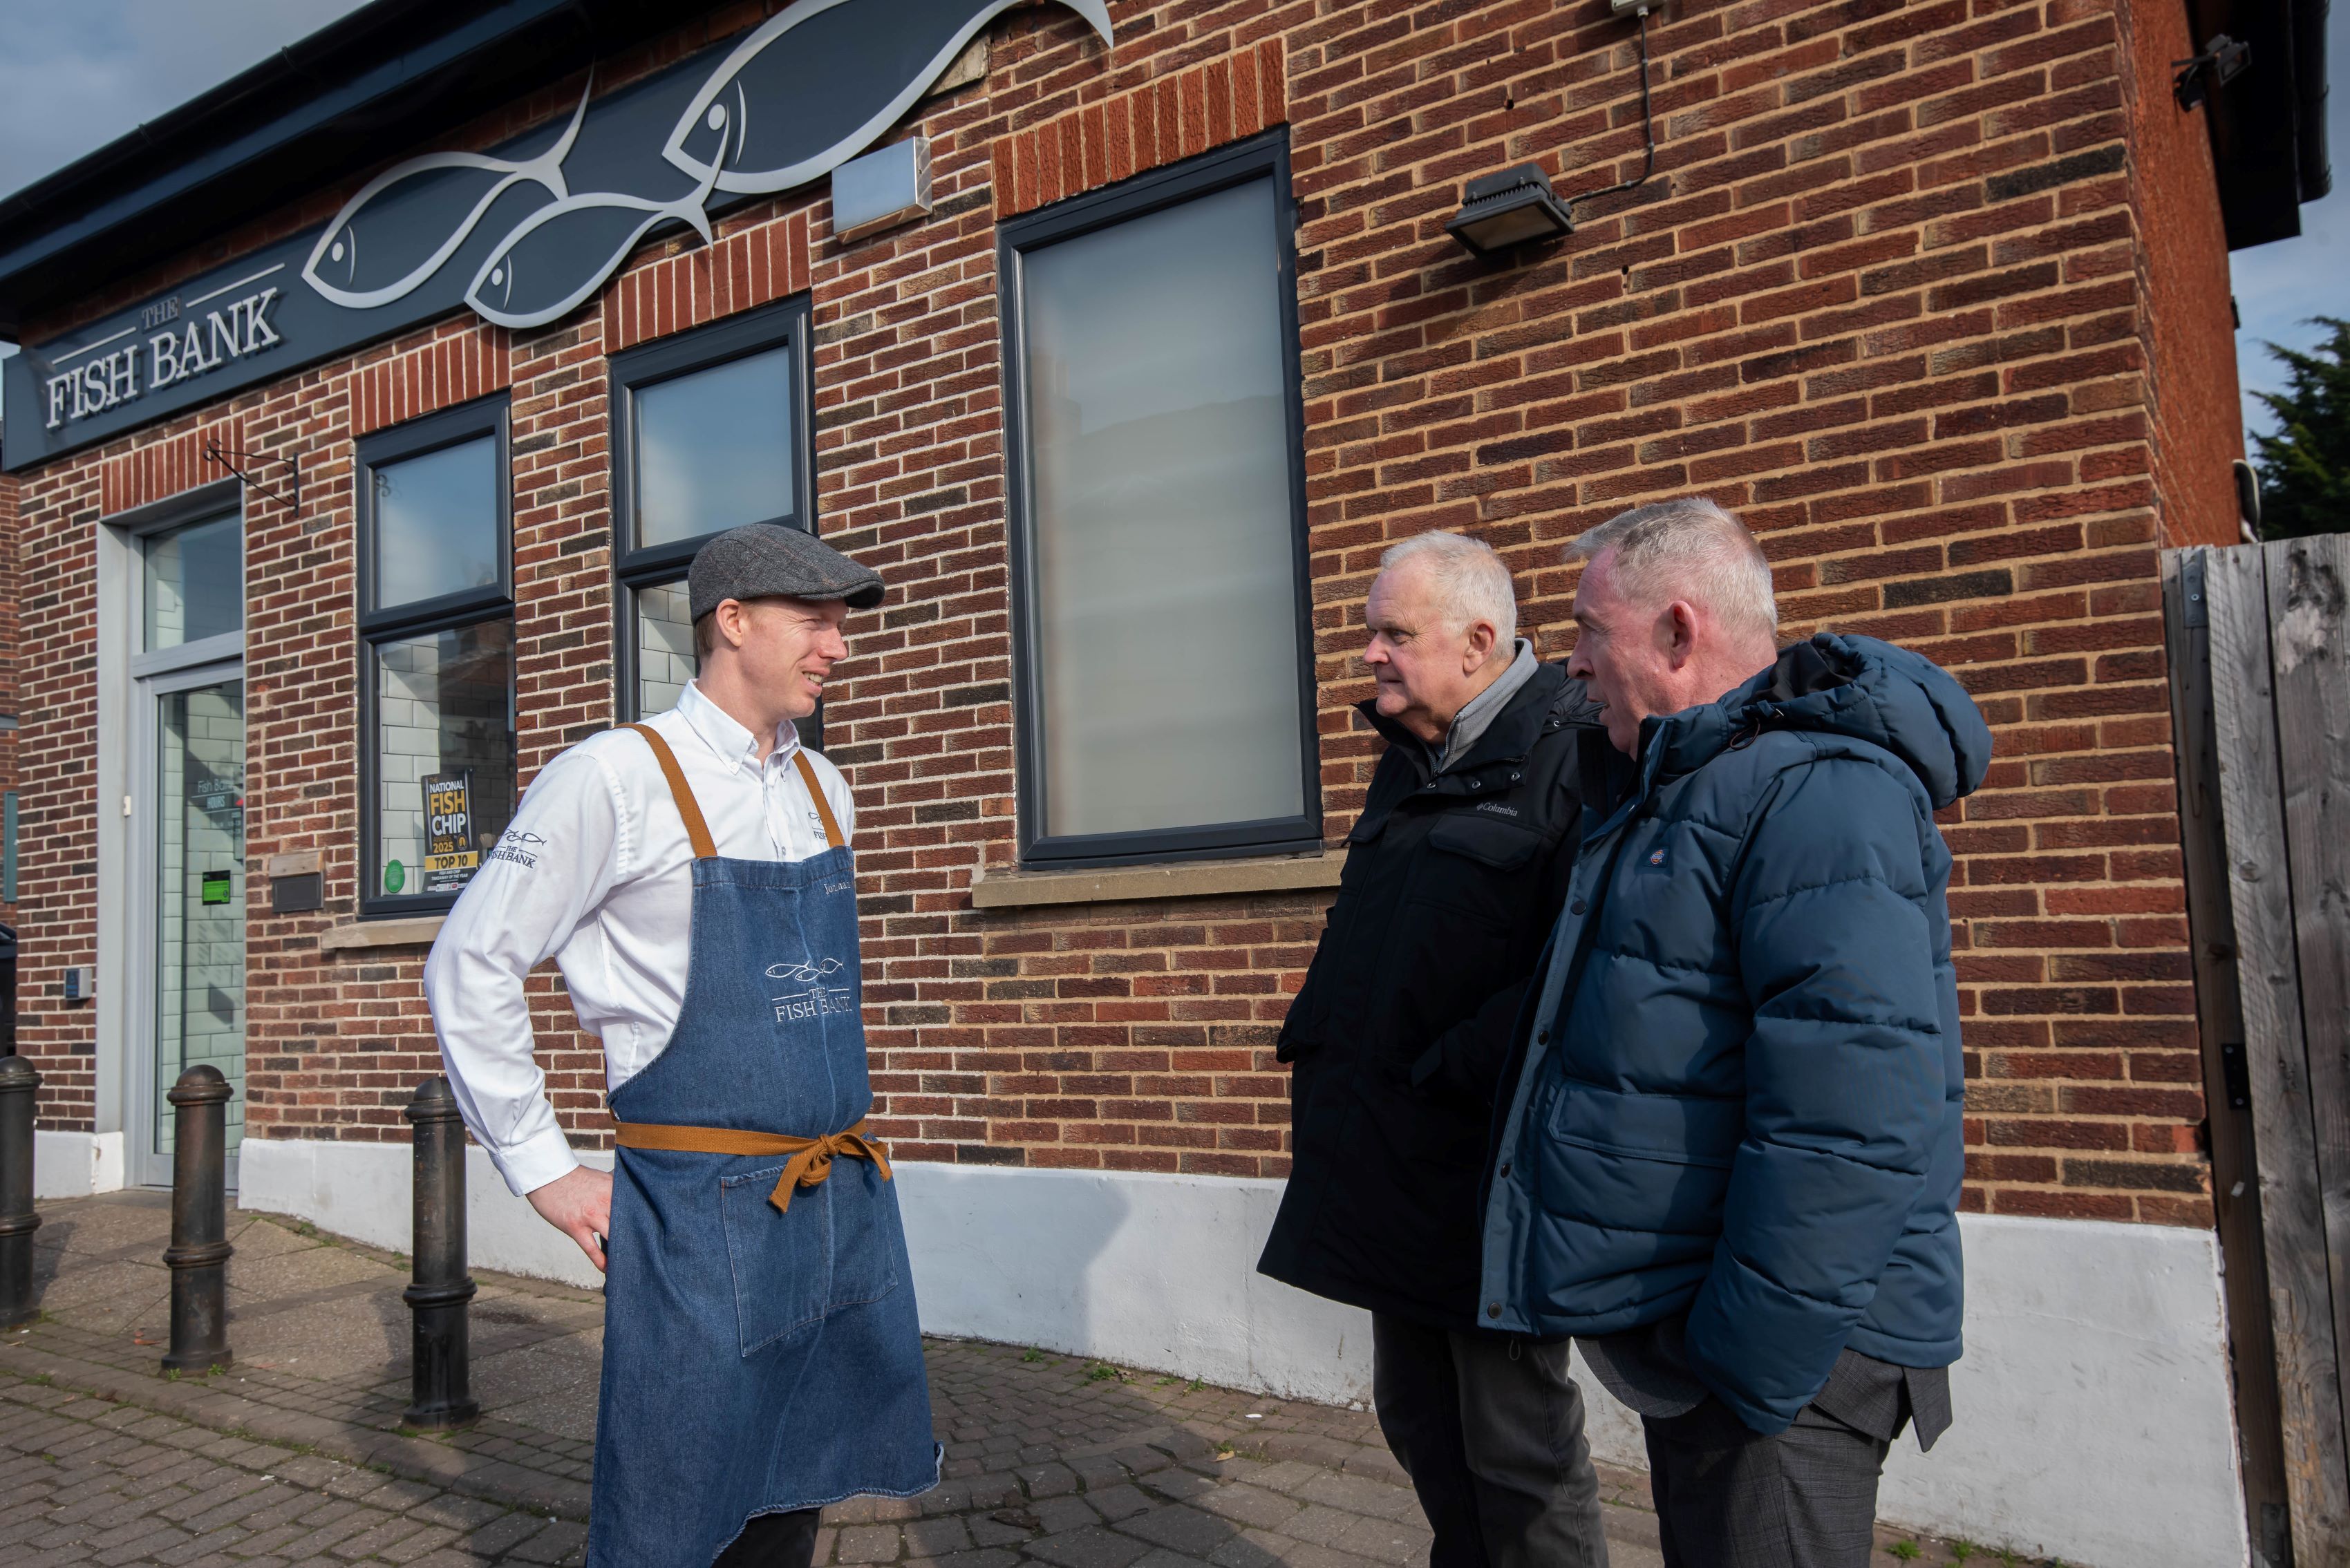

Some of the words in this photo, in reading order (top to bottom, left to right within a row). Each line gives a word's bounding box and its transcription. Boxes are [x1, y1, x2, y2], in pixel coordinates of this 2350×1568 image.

[142, 296, 180, 330] THE
[46, 345, 138, 428] FISH
[149, 287, 279, 388] BANK
[429, 780, 464, 793] NATIONAL
[430, 790, 466, 815] FISH
[1483, 802, 1518, 817] Columbia
[431, 813, 467, 835] CHIP
[433, 841, 454, 853] 2025
[434, 856, 455, 869] TOP
[458, 854, 468, 867] 10
[505, 852, 536, 869] BANK
[809, 988, 827, 999] THE
[773, 1000, 818, 1023] FISH
[819, 996, 852, 1014] BANK
